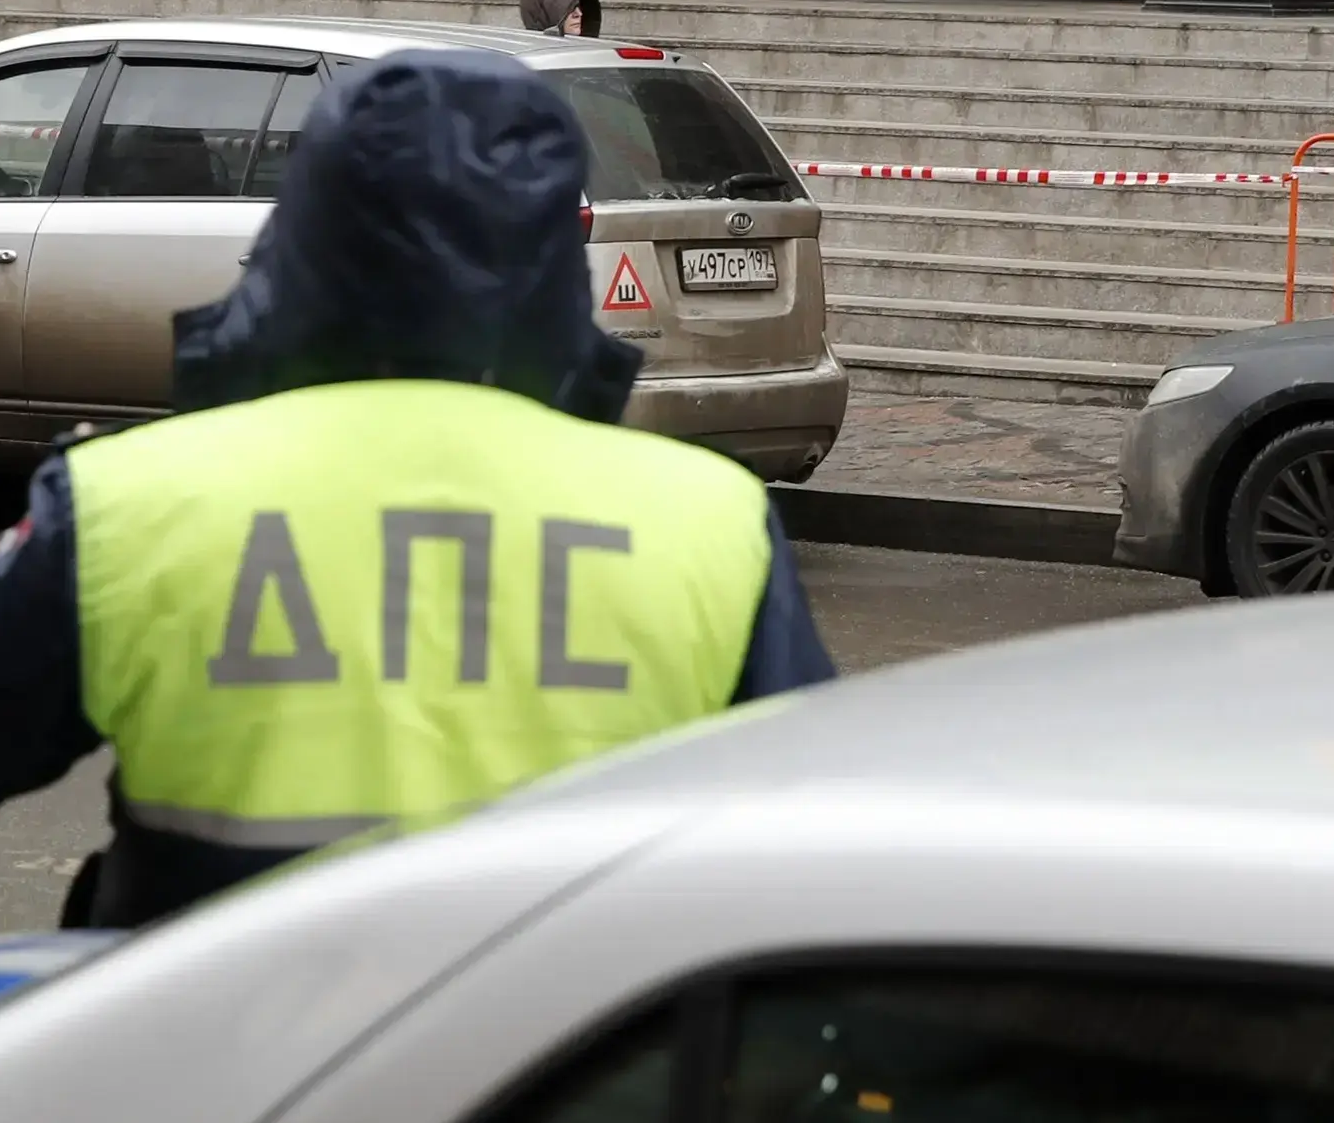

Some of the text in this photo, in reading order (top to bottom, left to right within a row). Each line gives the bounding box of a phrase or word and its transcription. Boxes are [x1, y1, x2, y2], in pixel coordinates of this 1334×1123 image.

[748, 250, 770, 271] 197
[618, 284, 636, 302] Ш
[208, 507, 632, 693] ДПС
